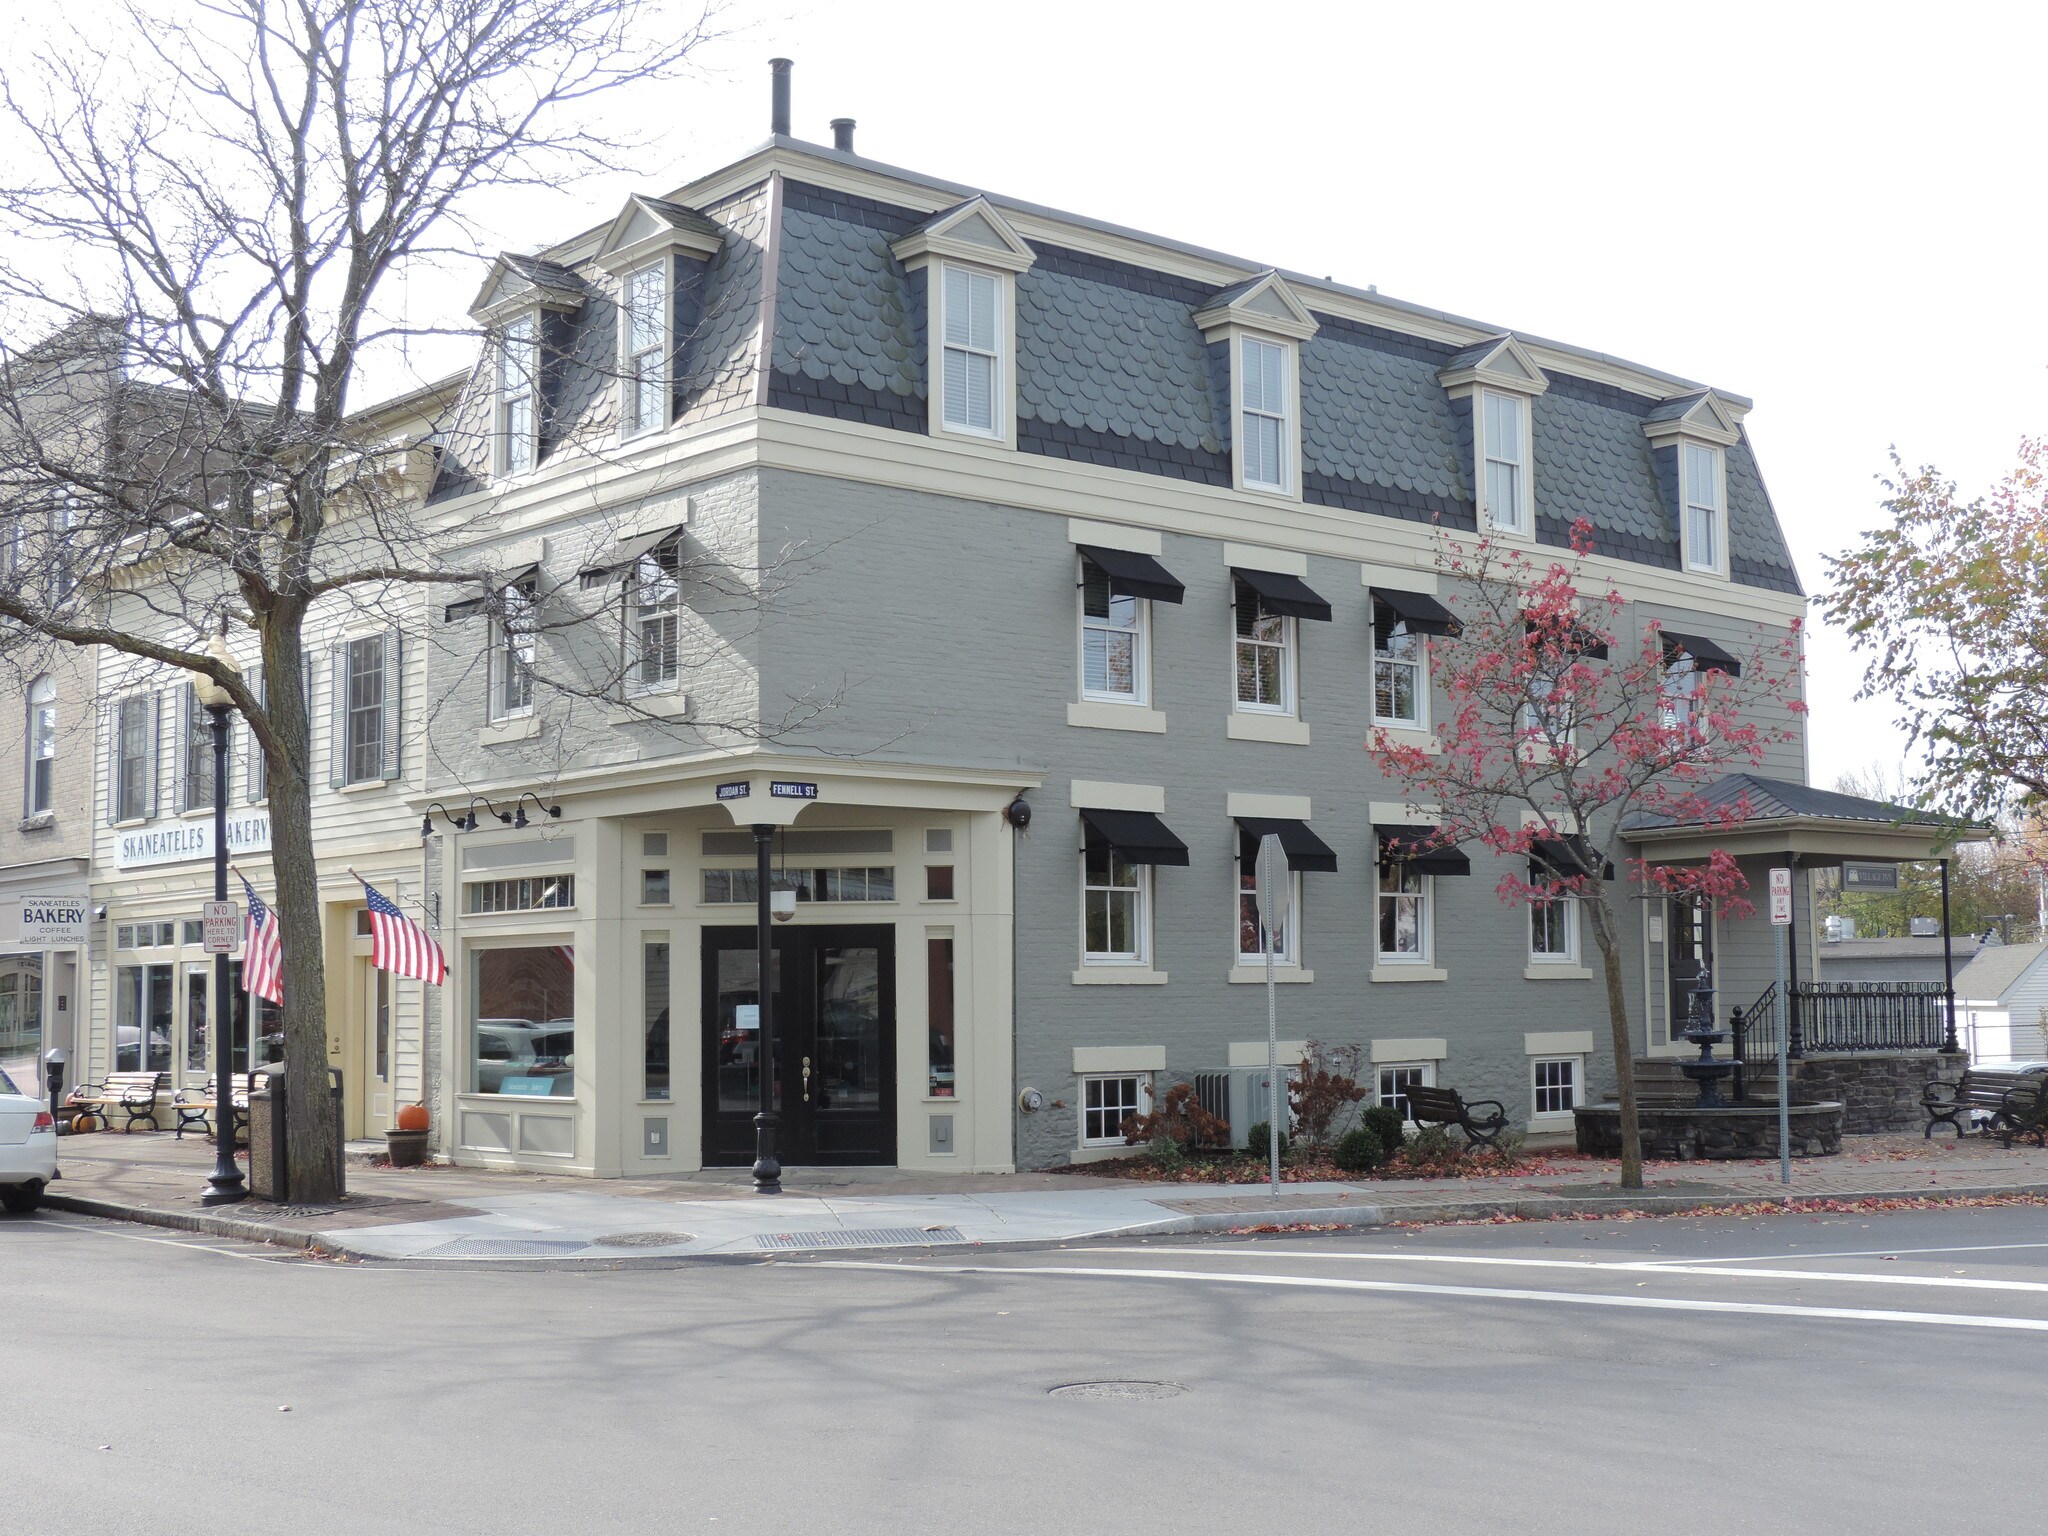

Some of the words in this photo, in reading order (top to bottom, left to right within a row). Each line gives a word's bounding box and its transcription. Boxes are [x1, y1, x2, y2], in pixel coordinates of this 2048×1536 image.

[720, 785, 738, 797] JORDAN
[773, 784, 803, 795] FENNELL
[805, 786, 815, 796] ST.
[123, 827, 204, 858] SKANEATELES
[226, 817, 269, 844] AKERY
[1776, 873, 1784, 884] NO
[1771, 886, 1790, 897] PARKING
[23, 908, 86, 924] BAKERY
[213, 905, 228, 916] NO
[205, 916, 237, 928] PARKING
[207, 928, 225, 936] HERE
[226, 927, 236, 935] TO
[51, 935, 85, 943] LUNCHES
[207, 935, 235, 944] CORNER
